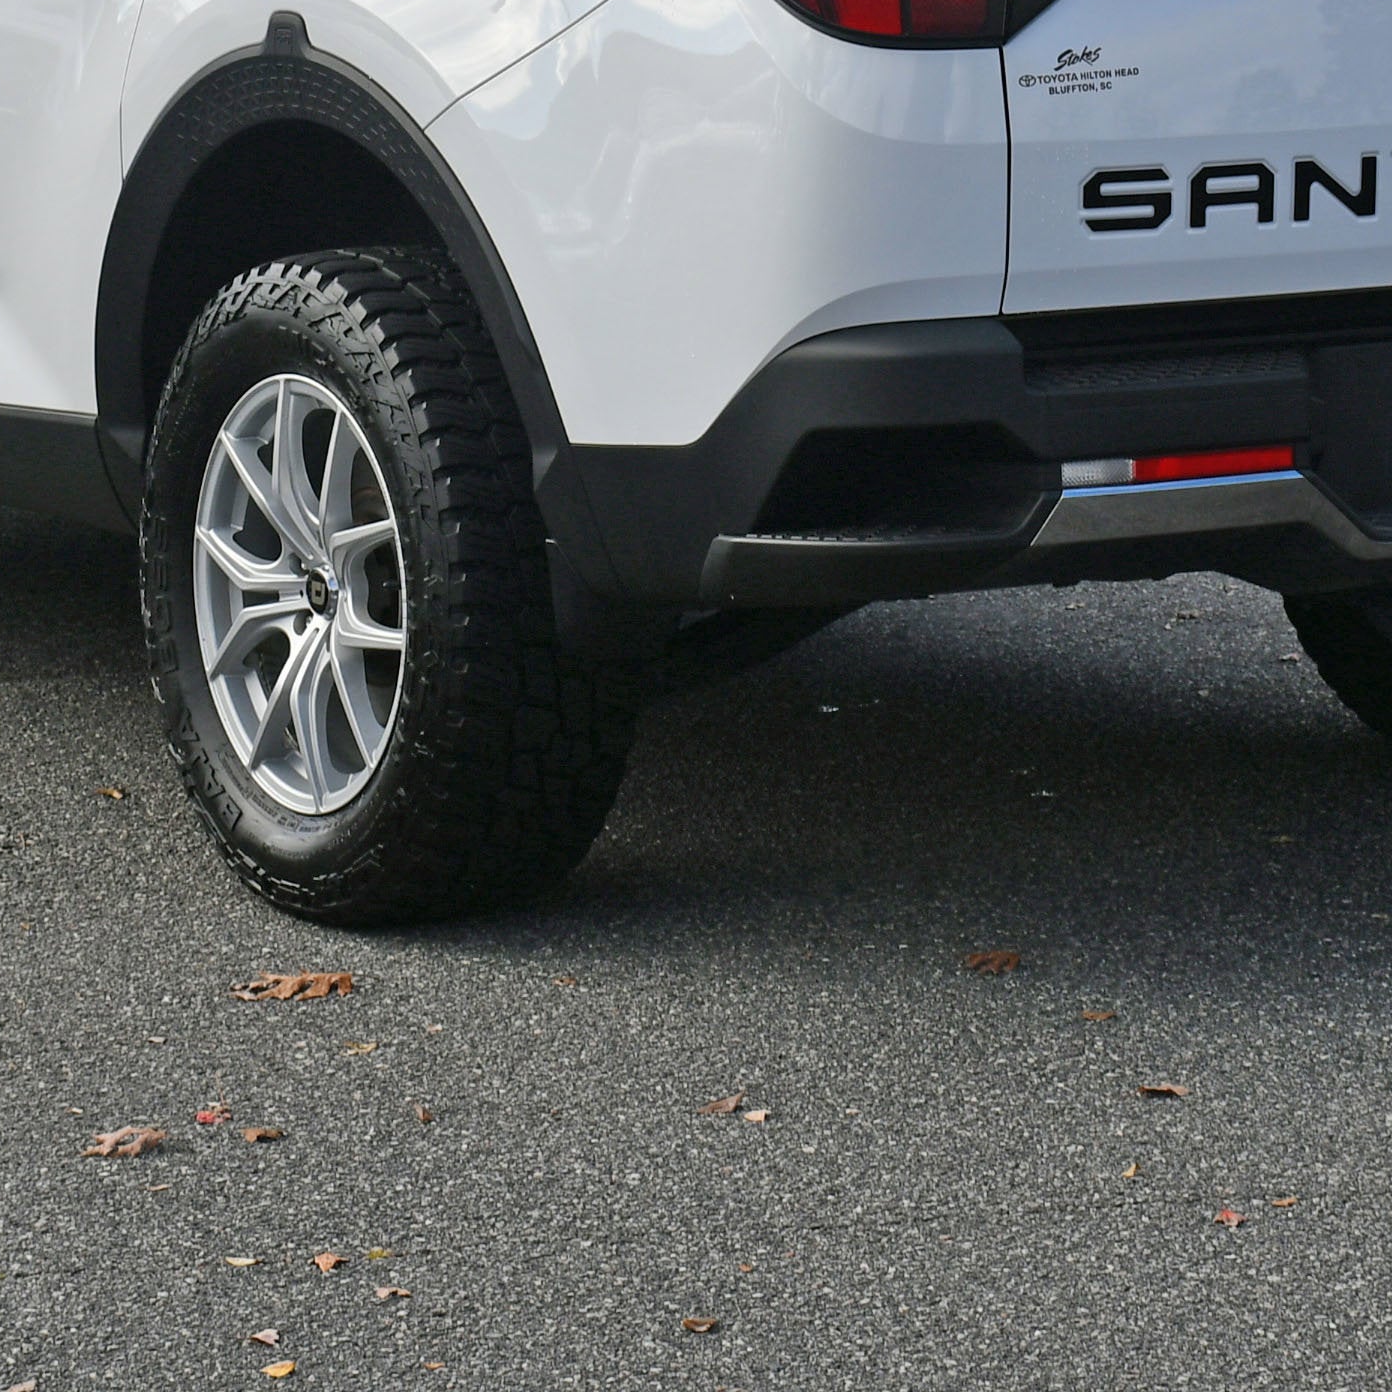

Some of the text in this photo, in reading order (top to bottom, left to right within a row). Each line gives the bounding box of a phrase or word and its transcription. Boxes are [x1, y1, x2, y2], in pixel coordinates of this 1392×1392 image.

[1054, 45, 1102, 71] Stokes
[1037, 67, 1140, 85] TOYOTA HILTON HEAD
[1048, 81, 1113, 95] BLUFFTON, SC
